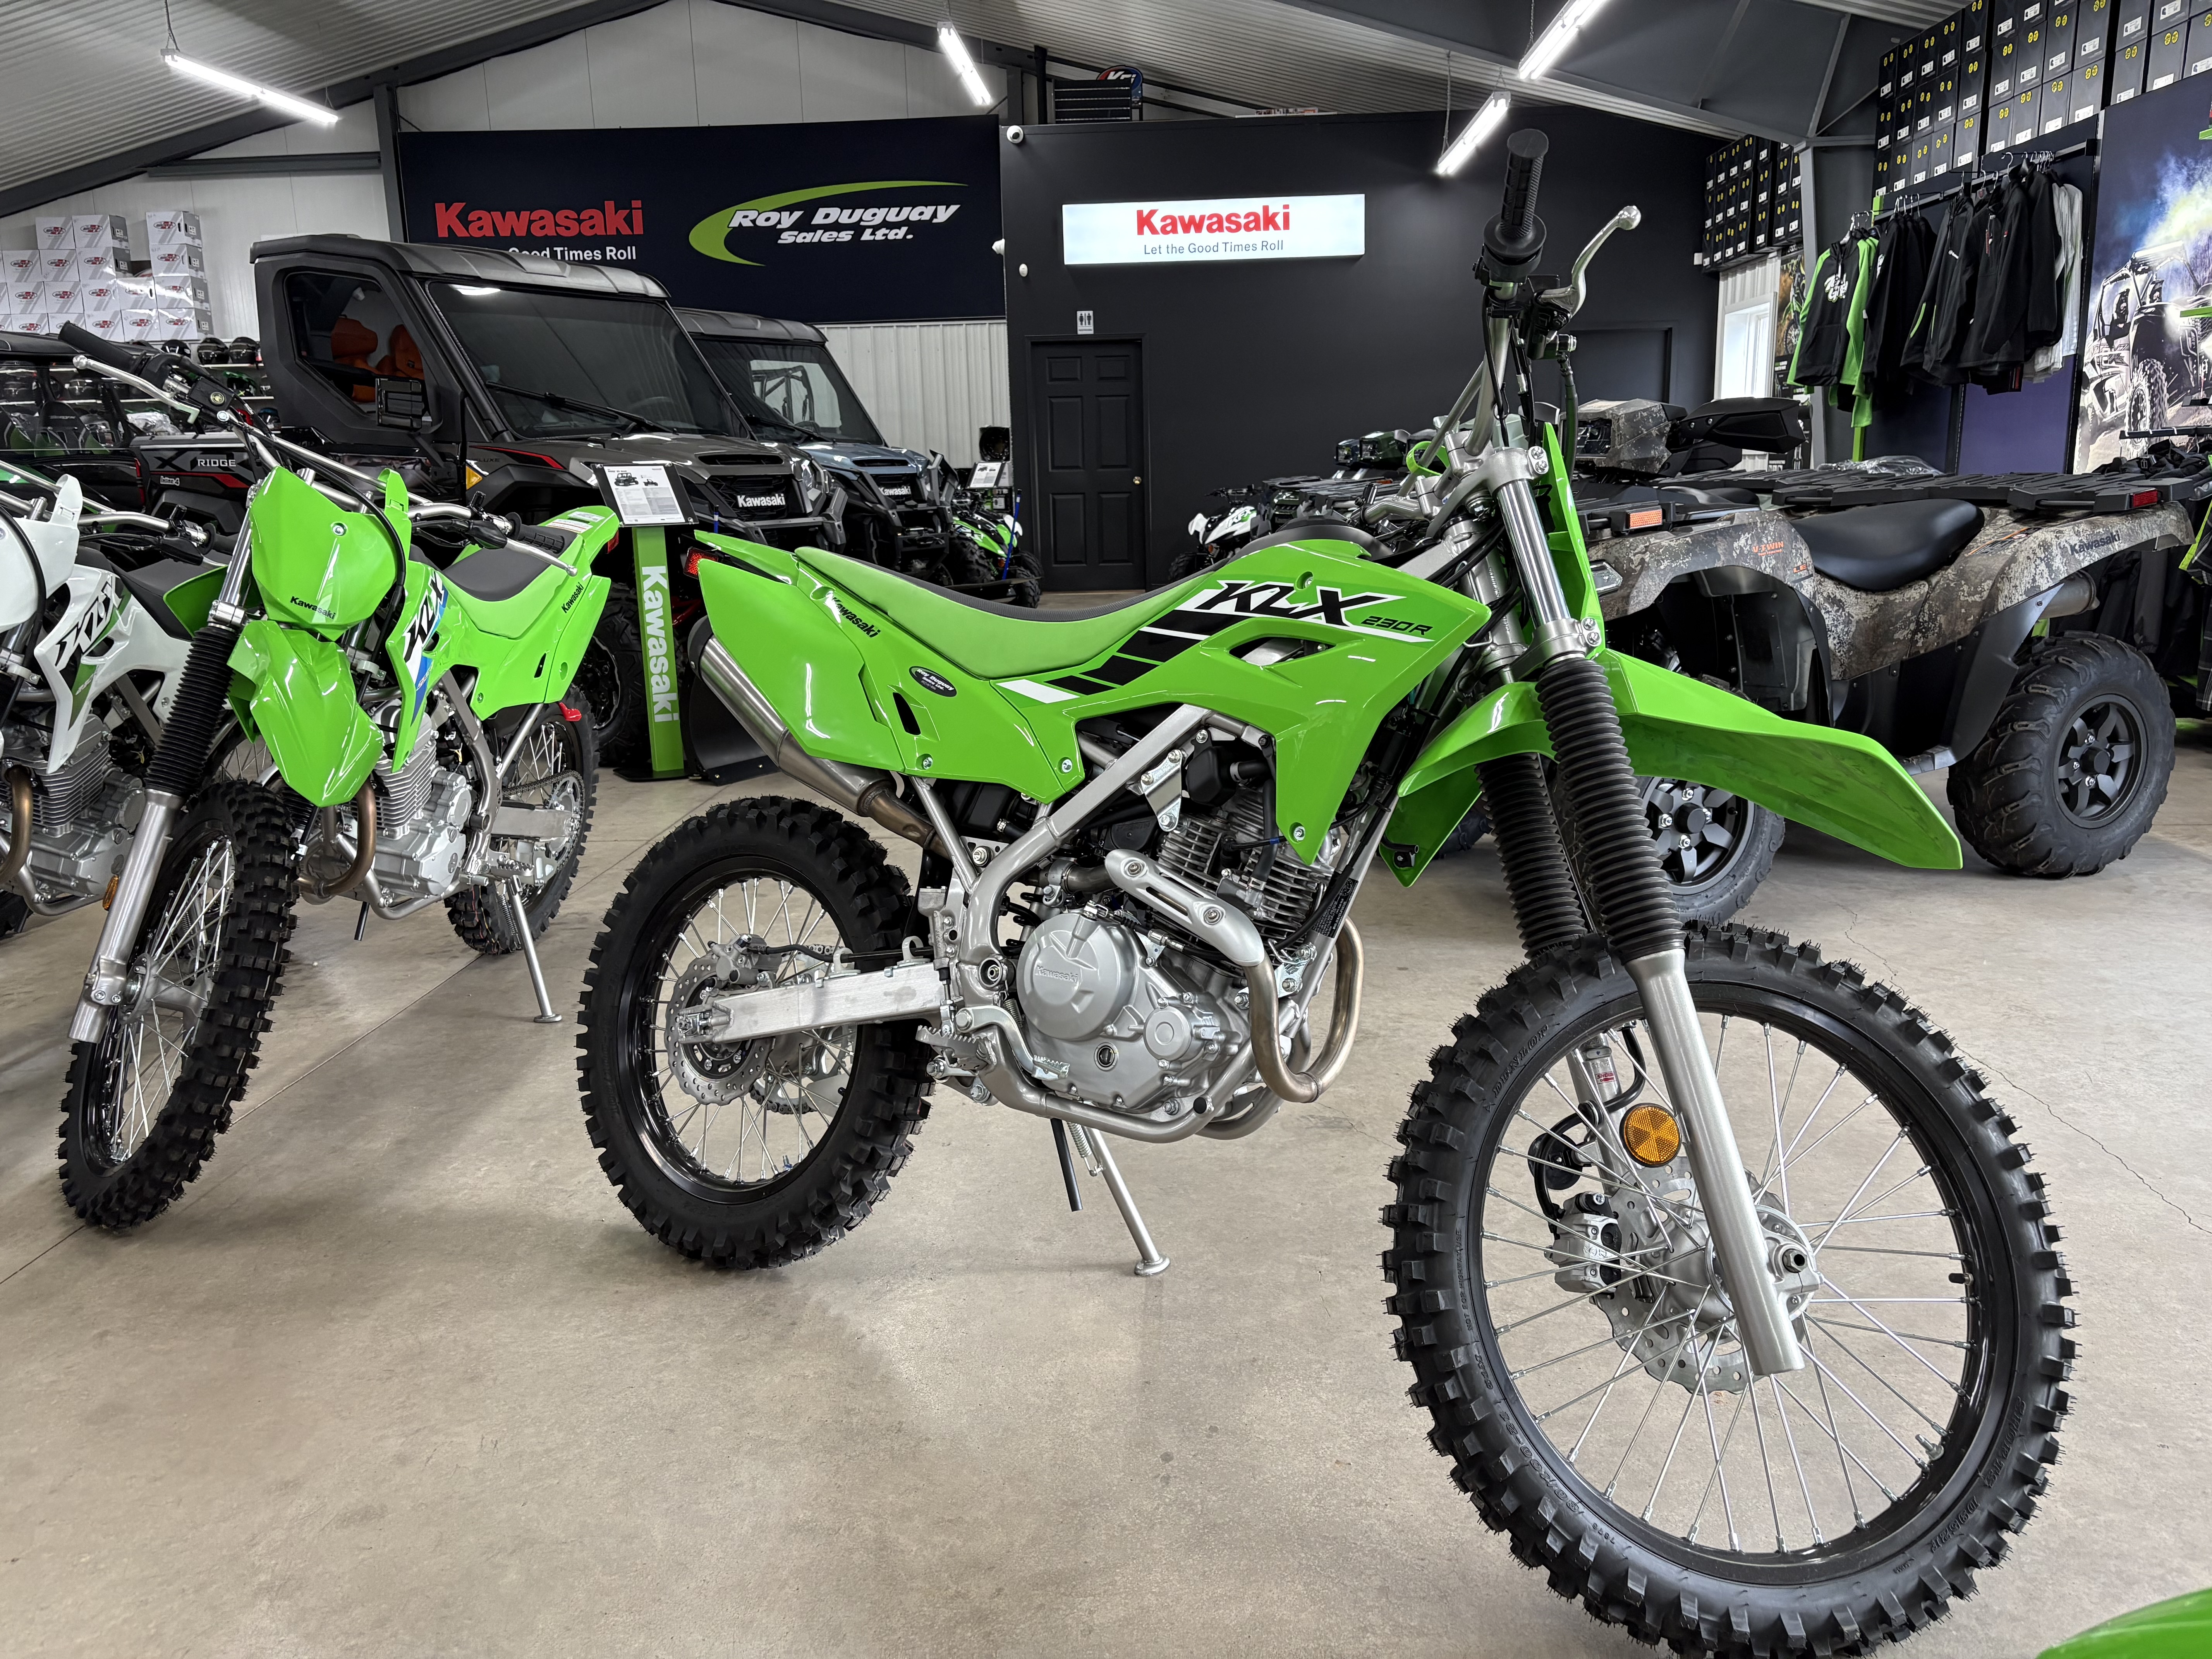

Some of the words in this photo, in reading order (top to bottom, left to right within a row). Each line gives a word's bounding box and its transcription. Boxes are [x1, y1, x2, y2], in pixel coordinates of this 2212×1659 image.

[435, 200, 644, 238] Kawasaki
[728, 210, 805, 228] Roy
[811, 204, 961, 226] Duguay
[1137, 204, 1290, 235] Kawasaki
[778, 230, 854, 244] Sales
[860, 227, 914, 240] Ltd.
[1144, 244, 1161, 254] Let
[1166, 243, 1185, 254] the
[1188, 242, 1219, 253] Good
[1222, 241, 1257, 252] Times
[1261, 240, 1284, 251] Roll
[554, 247, 602, 260] Times
[606, 246, 636, 260] Roll
[737, 493, 785, 508] Kawasaki
[879, 486, 911, 496] Kawasaki
[1752, 541, 1784, 553] V-TWIN
[2069, 531, 2121, 556] Kawasaki
[1793, 564, 1807, 573] LE
[290, 596, 336, 620] Kawasaki
[562, 582, 584, 613] Kawasaki
[1198, 582, 1387, 626] KLX
[831, 596, 881, 638] Kawasaki
[1361, 615, 1433, 635] 230R
[642, 566, 680, 722] Kawasaki
[929, 676, 954, 690] Duguay
[1036, 965, 1079, 983] Kawasaki
[1494, 1024, 1548, 1098] DUNLOP
[1463, 1312, 1473, 1331] NOT
[1985, 1396, 2025, 1488] SPORTS
[1500, 1410, 1580, 1513] 80/100-21
[1930, 1496, 1980, 1553] D952F
